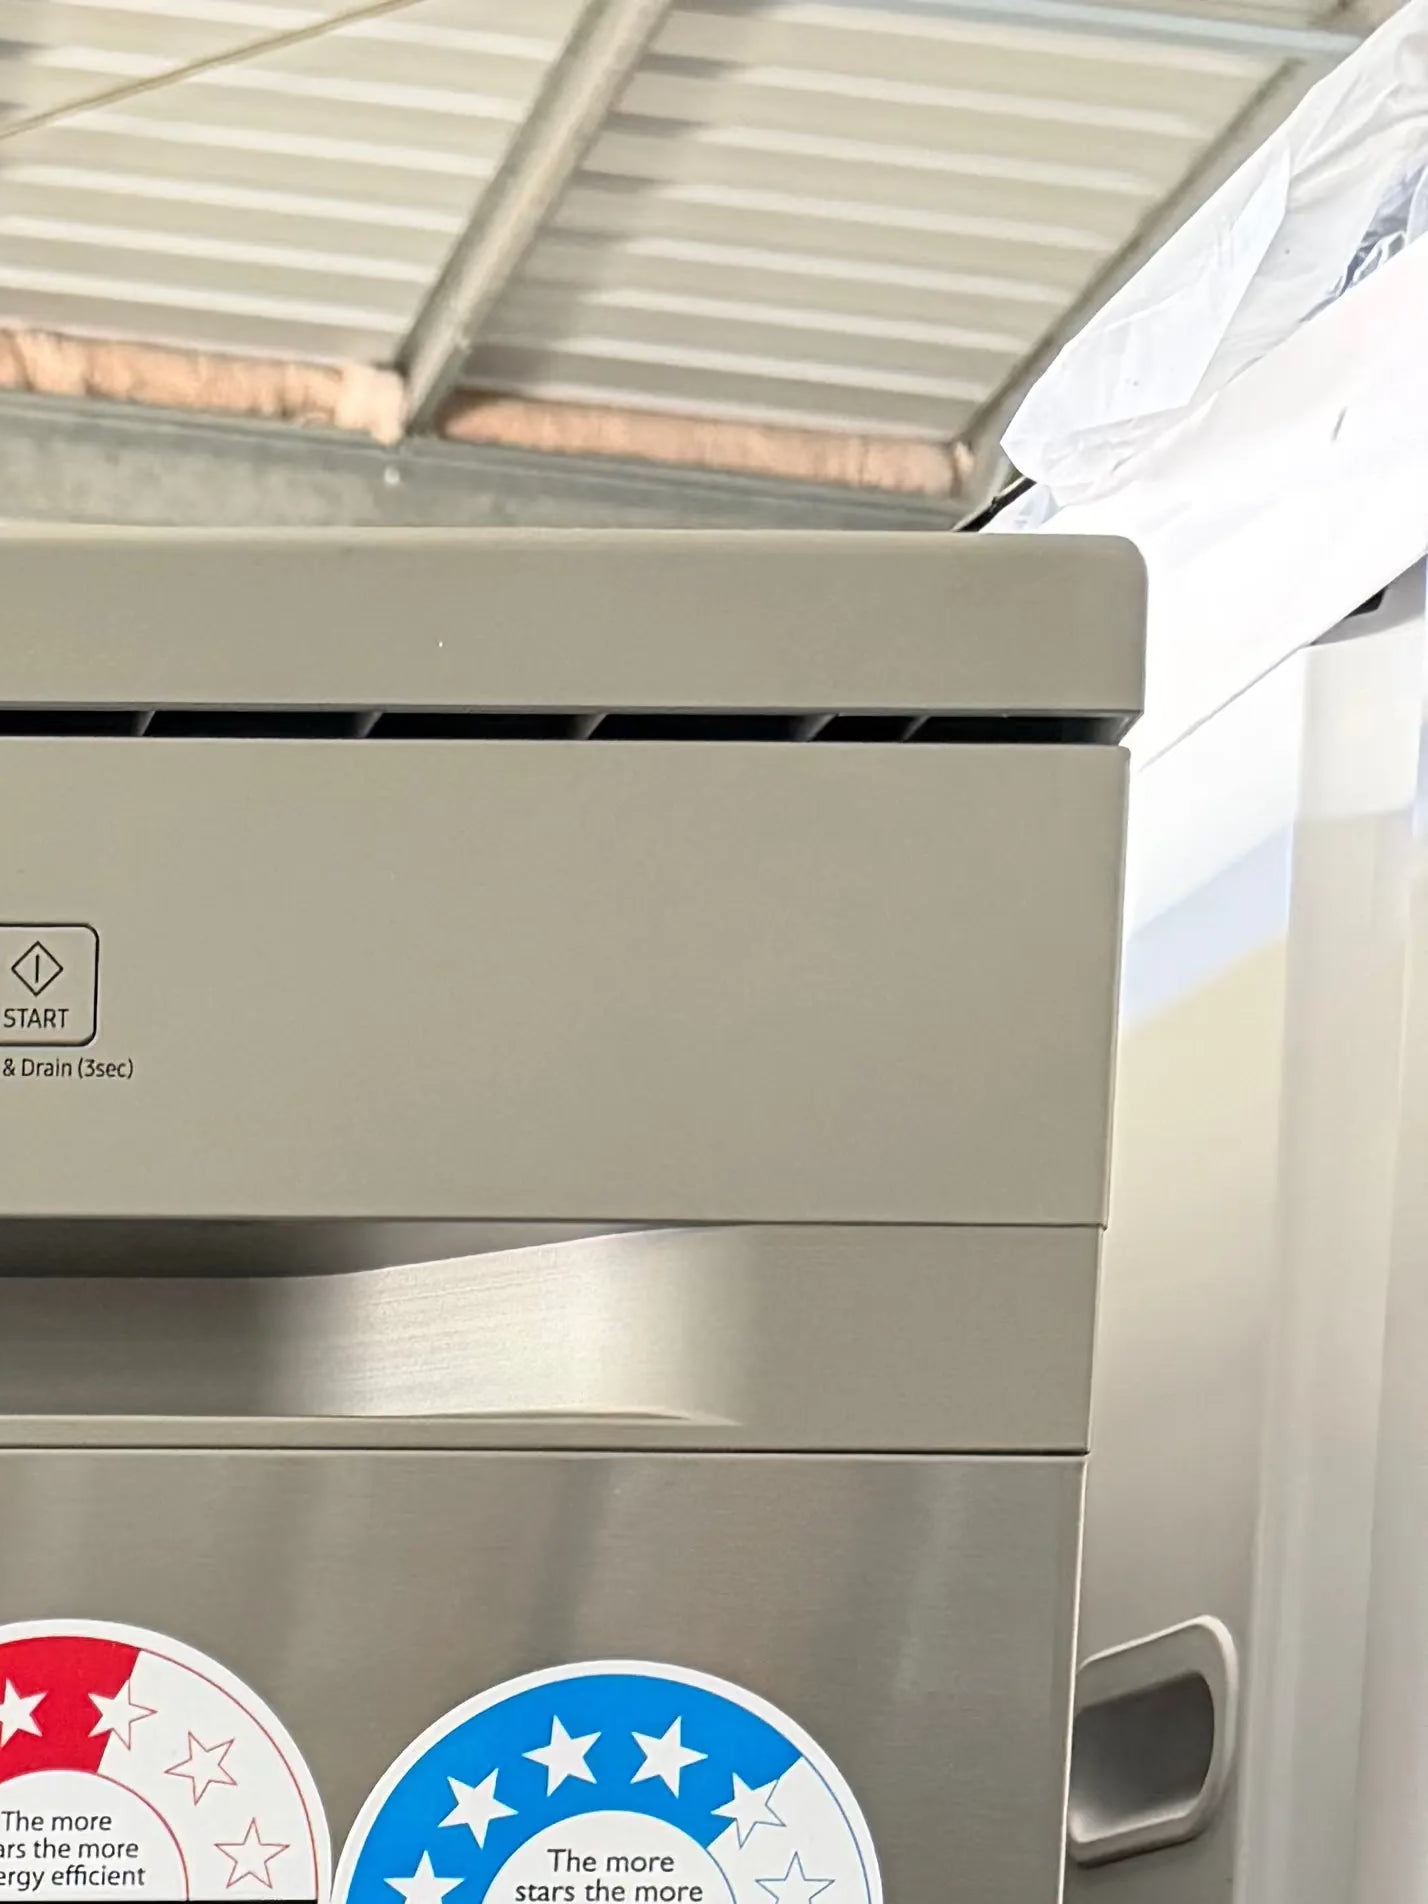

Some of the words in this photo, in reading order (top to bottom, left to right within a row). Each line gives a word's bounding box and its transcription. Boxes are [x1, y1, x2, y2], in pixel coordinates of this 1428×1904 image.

[2, 1008, 70, 1029] START
[2, 1058, 17, 1077] &
[21, 1057, 74, 1078] Drain
[77, 1057, 134, 1080] (3sec)
[1, 1810, 47, 1832] The
[51, 1814, 113, 1832] more
[32, 1837, 74, 1860] the
[77, 1842, 140, 1859] more
[547, 1848, 600, 1874] The
[605, 1854, 675, 1874] more
[51, 1865, 147, 1888] efficient
[515, 1882, 576, 1903] stars
[584, 1878, 630, 1902] the
[634, 1884, 704, 1903] more
